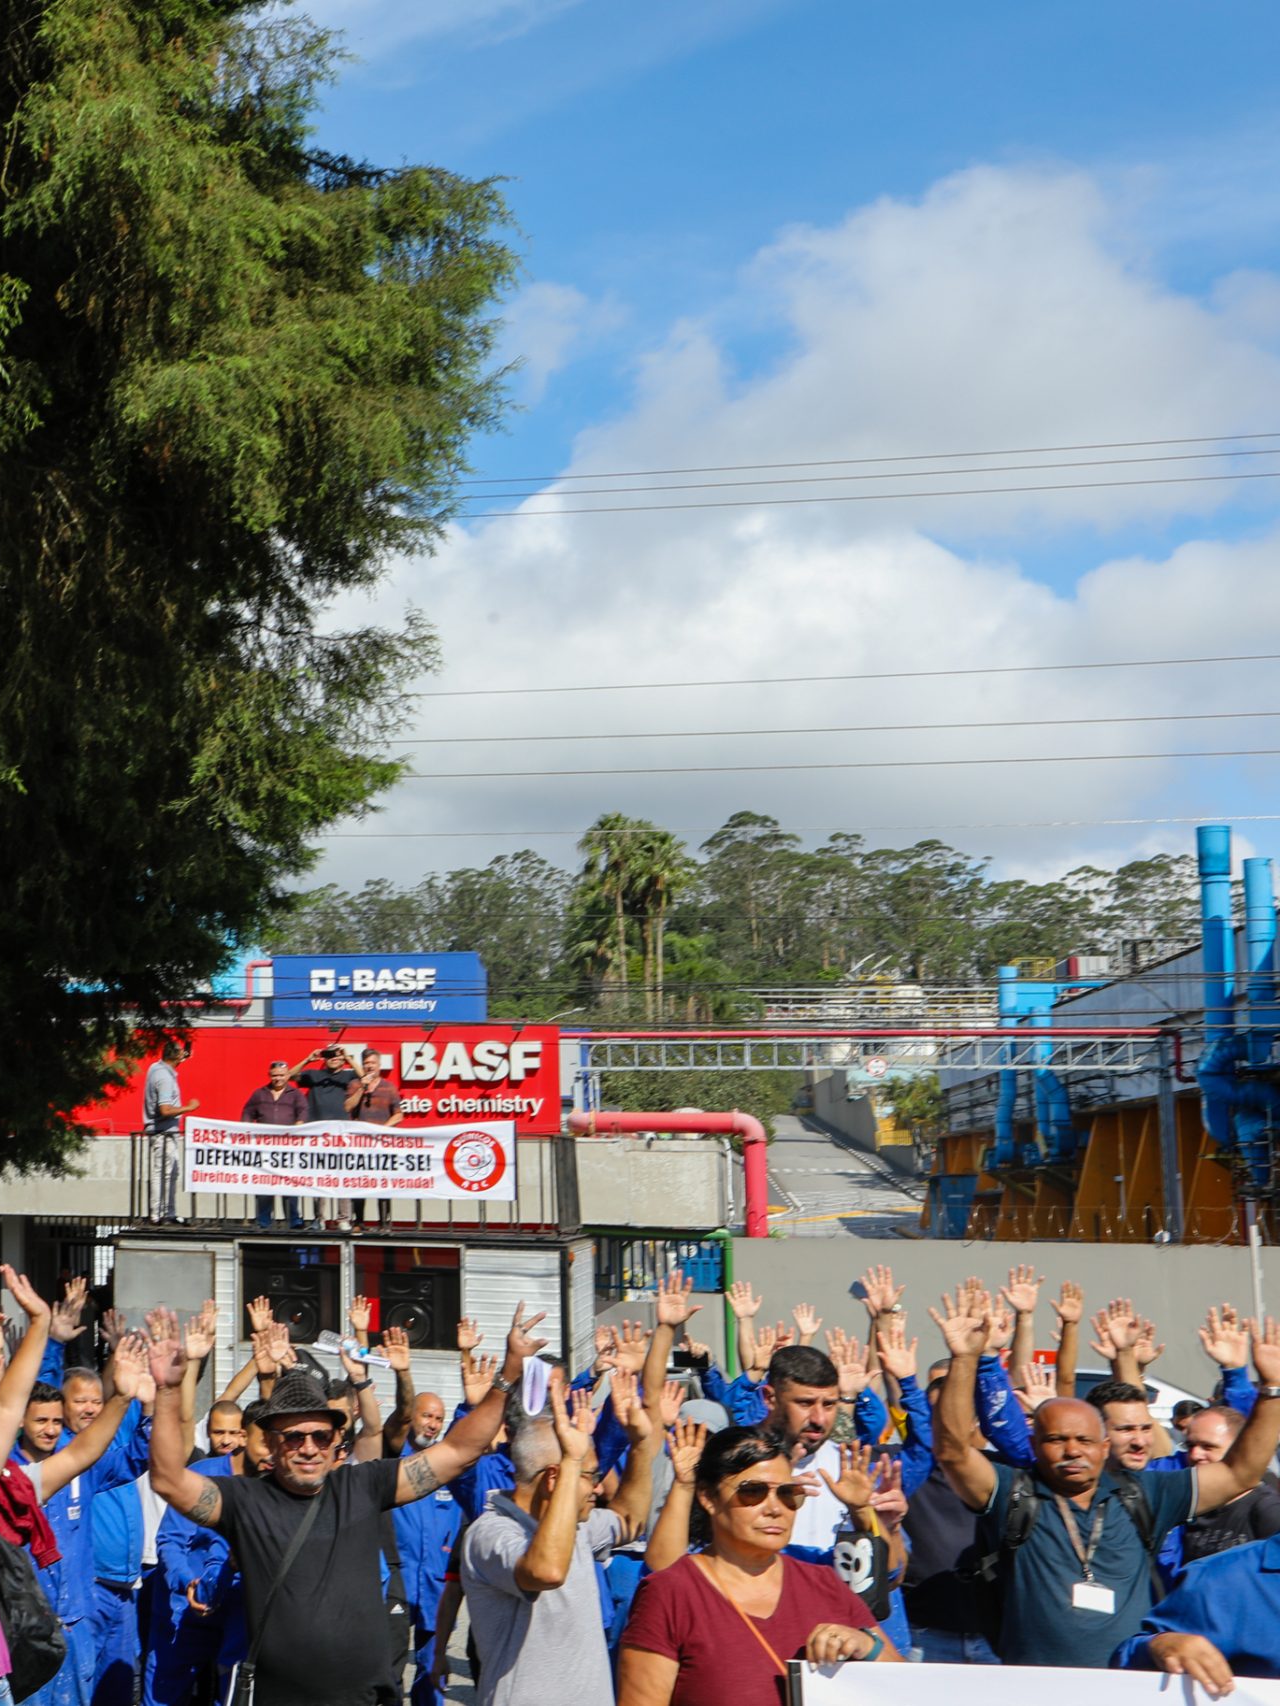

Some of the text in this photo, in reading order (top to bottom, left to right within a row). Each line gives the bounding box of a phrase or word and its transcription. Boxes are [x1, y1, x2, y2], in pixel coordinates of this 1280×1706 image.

[352, 967, 437, 991] BASF
[311, 998, 437, 1012] We create chemistry
[401, 1040, 542, 1081] BASF
[400, 1094, 544, 1117] ate chemistry
[192, 1128, 227, 1143] BASF
[229, 1131, 252, 1146] vai
[255, 1132, 306, 1147] vender
[195, 1148, 432, 1171] DEFENDA-SE! SINDICALIZE-SE!
[191, 1169, 239, 1183] Direitos
[241, 1173, 249, 1184] e
[252, 1173, 314, 1188] empregos
[317, 1174, 340, 1188] não
[343, 1174, 378, 1188] estão
[391, 1176, 435, 1189] venda!
